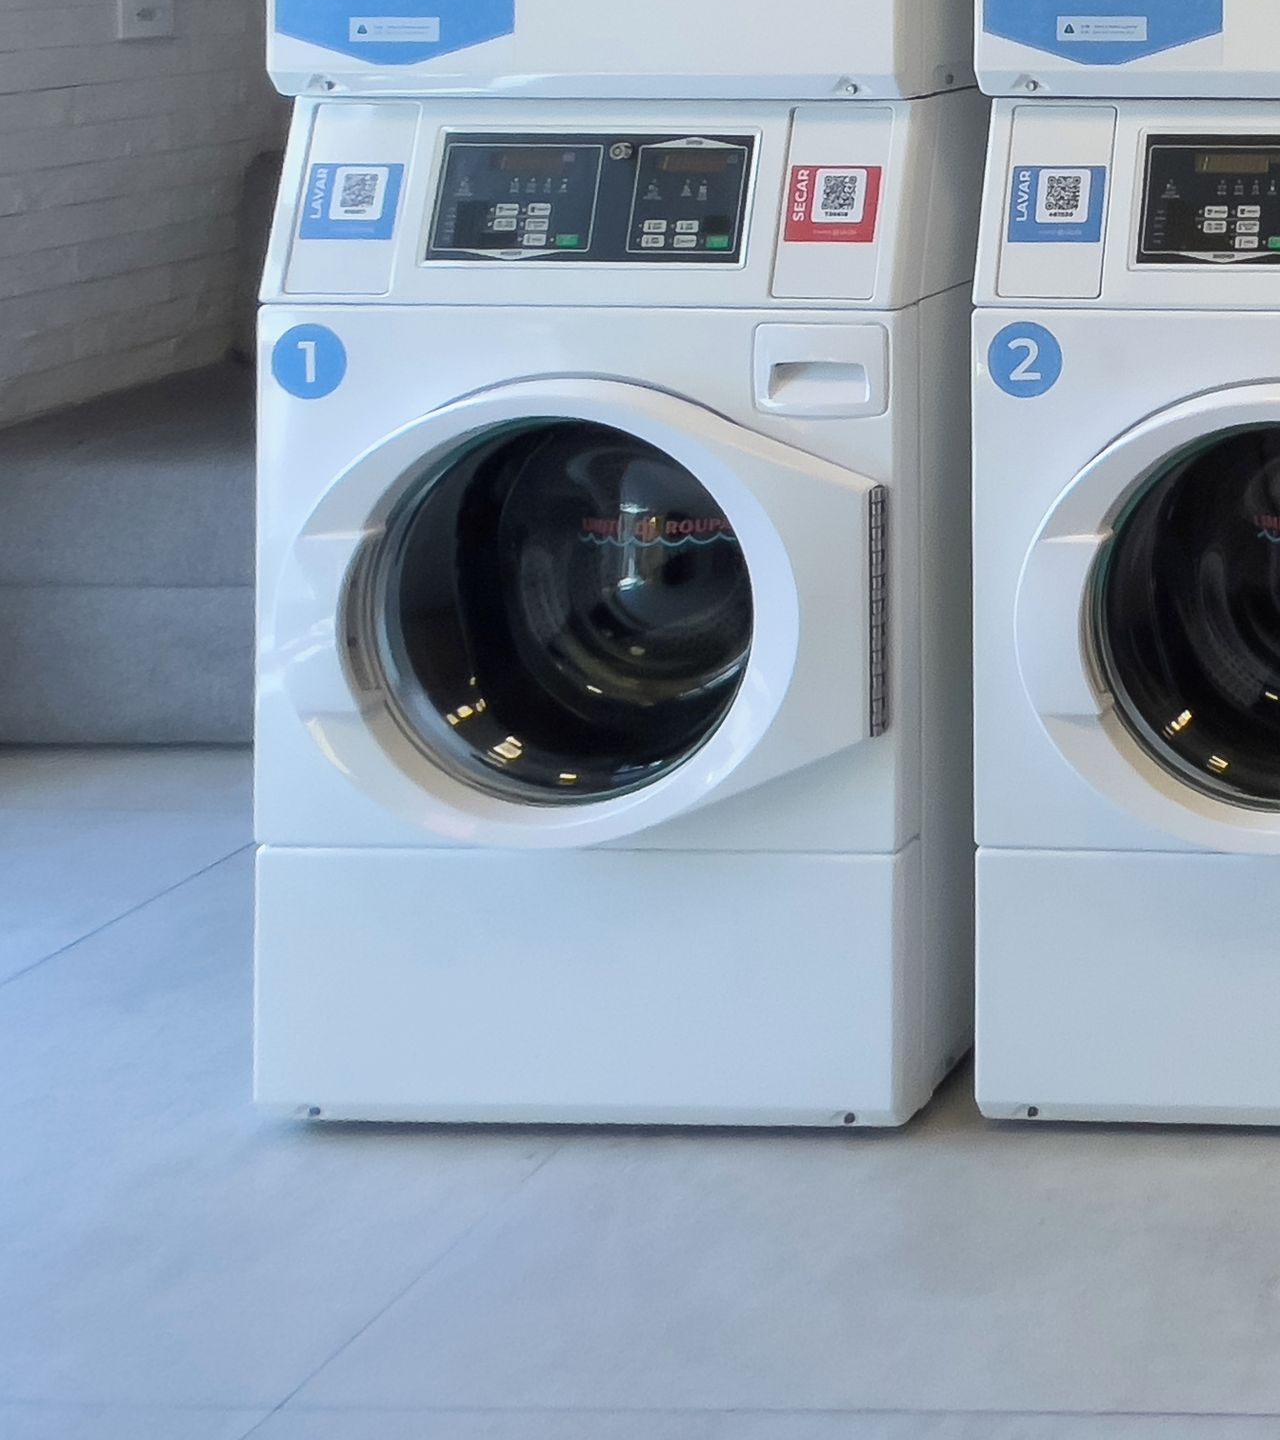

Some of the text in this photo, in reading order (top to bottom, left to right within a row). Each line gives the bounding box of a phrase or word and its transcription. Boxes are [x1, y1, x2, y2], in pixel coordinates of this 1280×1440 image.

[309, 167, 330, 219] LAVAR
[792, 169, 811, 221] SECAR
[1016, 170, 1032, 221] LAVAR
[298, 341, 316, 383] 1
[1008, 337, 1042, 381] 2
